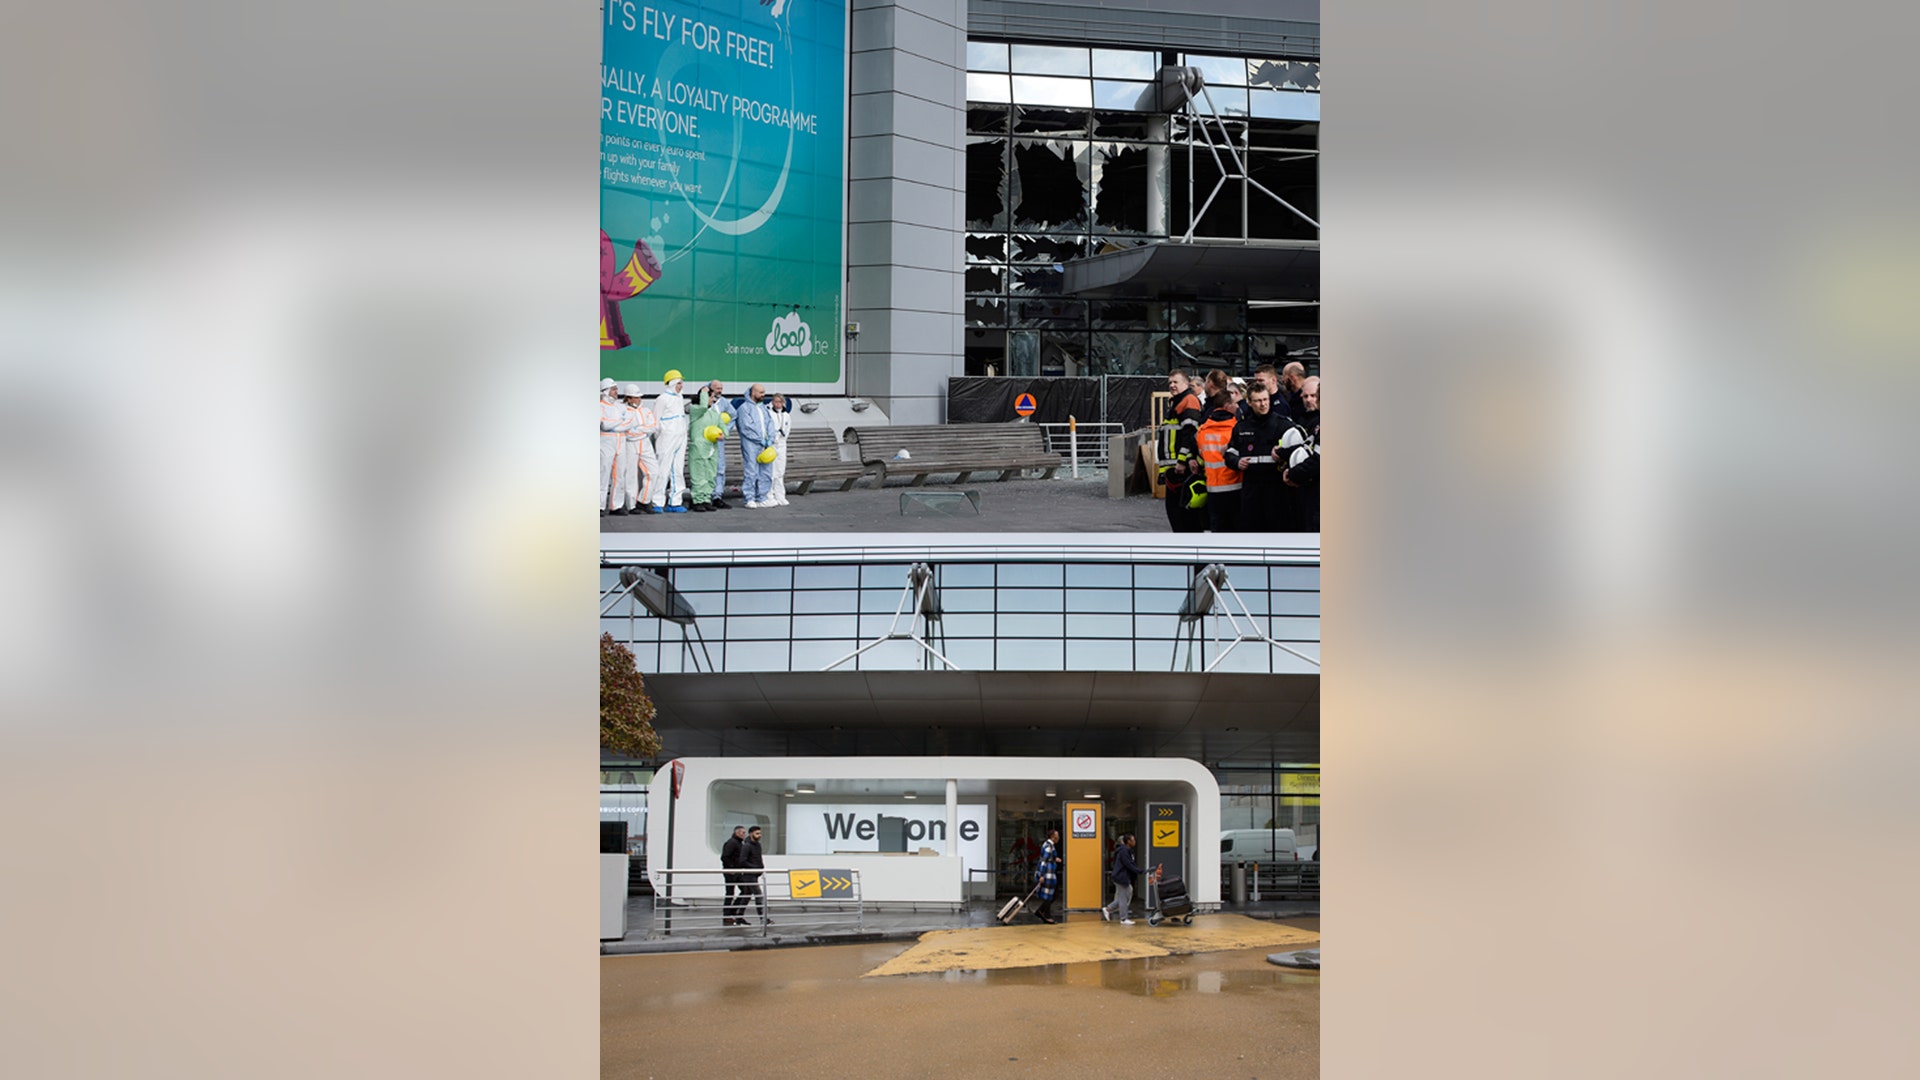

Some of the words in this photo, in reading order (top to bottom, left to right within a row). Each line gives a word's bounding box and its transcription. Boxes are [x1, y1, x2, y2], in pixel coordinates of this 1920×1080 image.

[643, 6, 676, 41] FLY
[681, 18, 720, 54] FOR
[617, 100, 700, 138] EVERYONE.
[650, 77, 663, 100] A
[667, 80, 728, 114] LOYALTY
[732, 96, 817, 135] PROGRAMME
[605, 133, 630, 146] points
[632, 139, 642, 149] on
[644, 142, 665, 156] every
[667, 145, 684, 157] euro
[604, 166, 629, 184] flights
[630, 172, 667, 188] whenever
[669, 180, 682, 192] you
[607, 153, 618, 165] up
[620, 152, 636, 166] with
[638, 158, 656, 170] your
[658, 157, 680, 176] family
[725, 343, 739, 354] Join
[740, 346, 754, 354] now
[756, 346, 764, 354] on
[770, 322, 806, 356] loop
